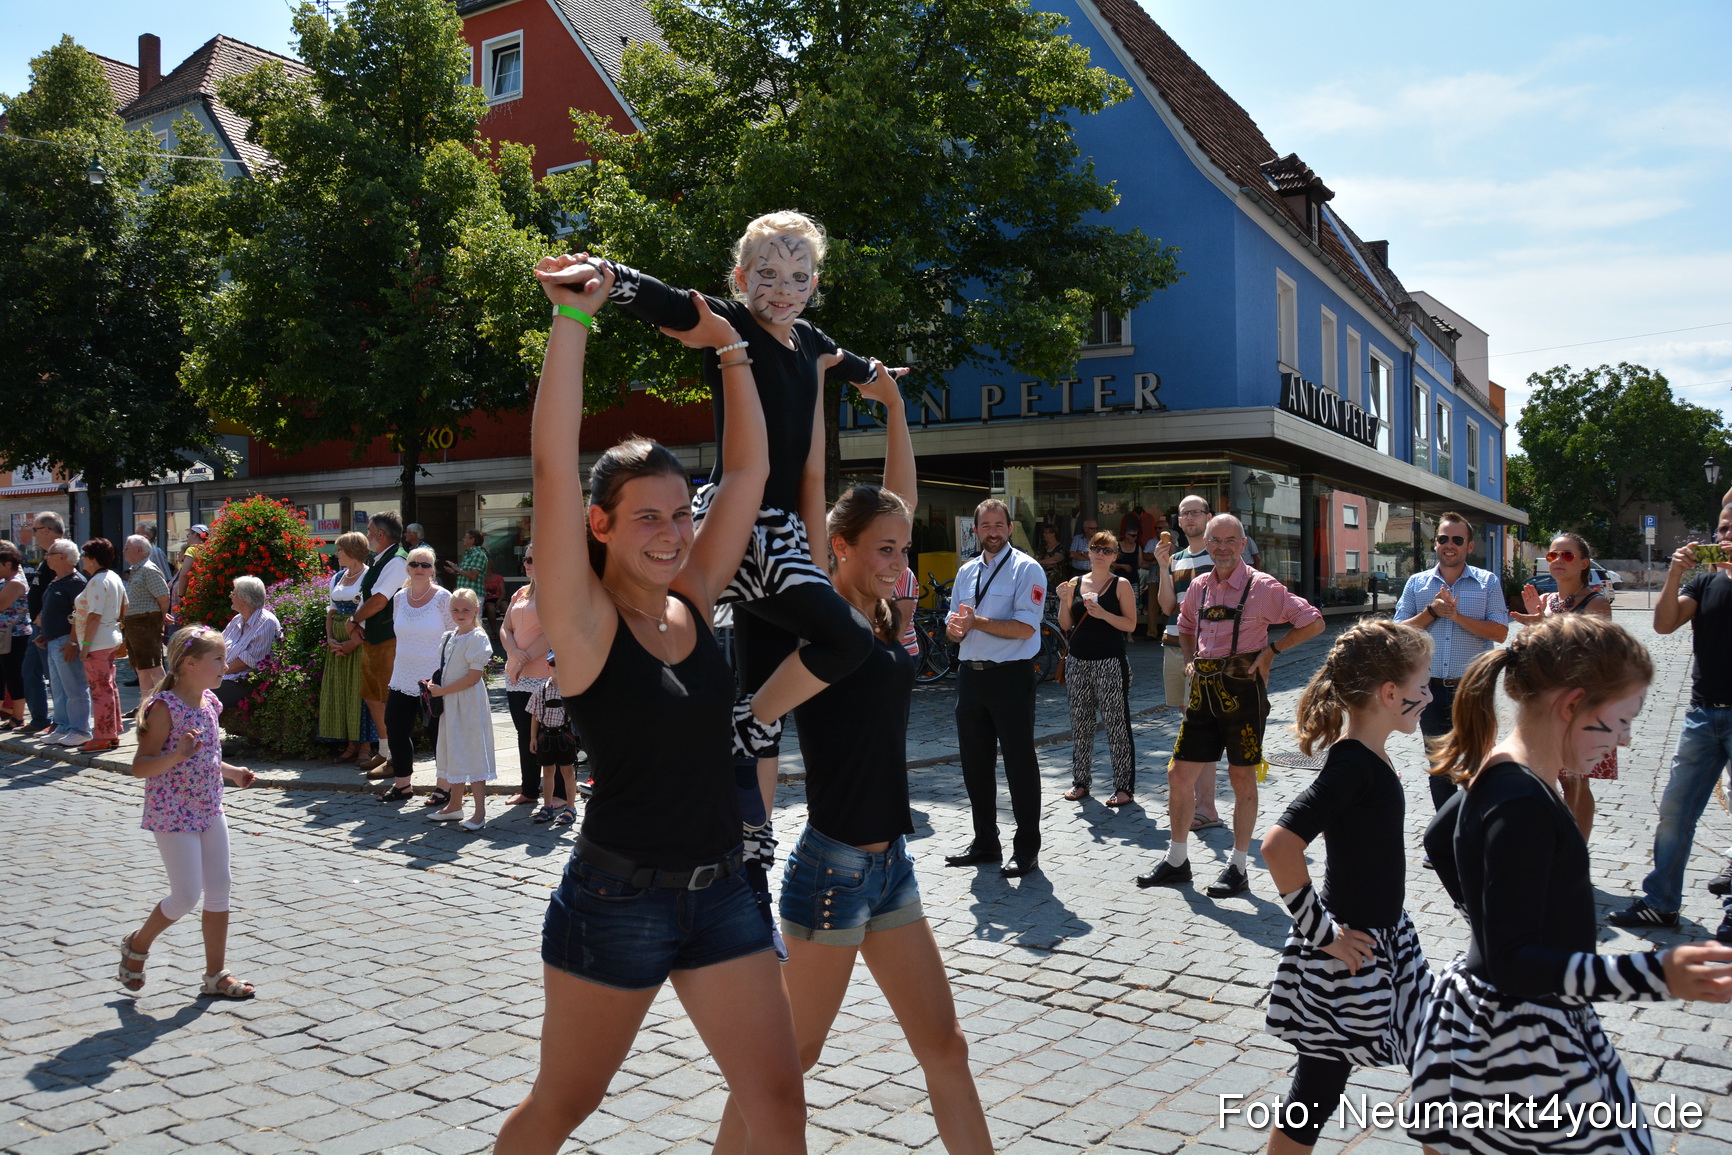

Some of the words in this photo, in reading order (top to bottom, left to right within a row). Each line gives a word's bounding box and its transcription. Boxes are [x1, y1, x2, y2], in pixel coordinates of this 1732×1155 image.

[980, 371, 1165, 421] PETER
[1288, 373, 1341, 430] ANTON
[1344, 400, 1382, 448] PETER
[1647, 517, 1654, 526] P
